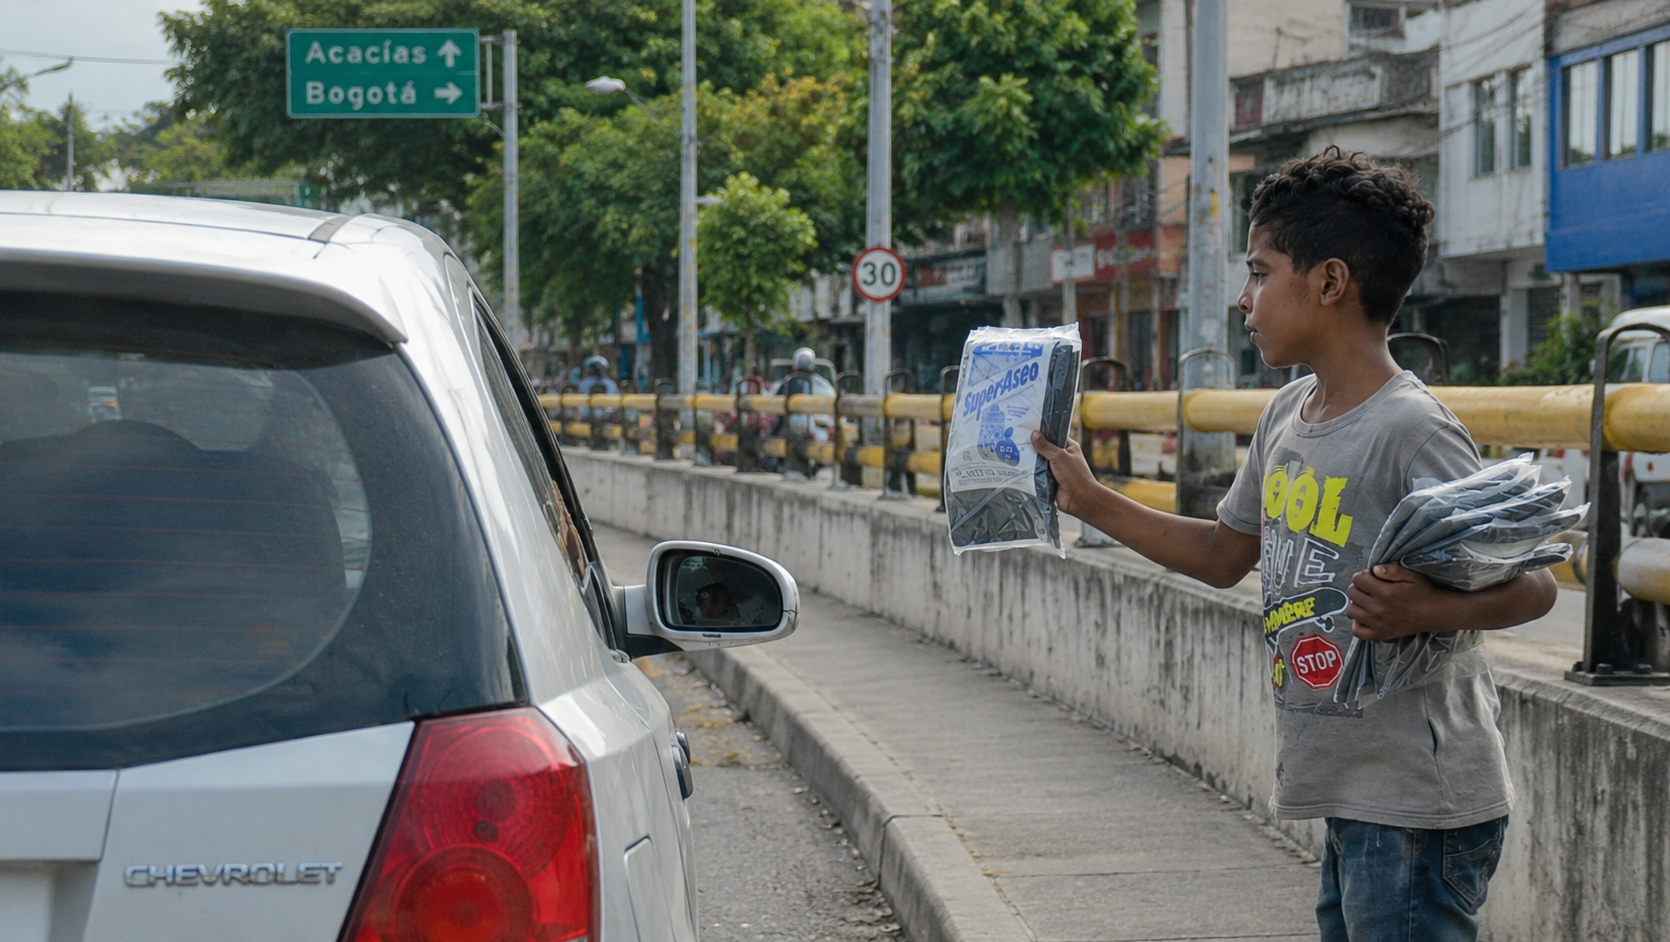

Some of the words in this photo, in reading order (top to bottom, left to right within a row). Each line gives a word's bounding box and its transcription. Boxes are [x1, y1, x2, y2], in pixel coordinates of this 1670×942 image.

[305, 39, 427, 65] Acacías
[306, 80, 417, 111] Bogotá
[862, 261, 896, 286] 30
[963, 361, 1040, 421] SuperAseo
[1263, 463, 1353, 548] OOL
[1296, 650, 1337, 675] STOP
[124, 861, 344, 888] CHEVROLET
